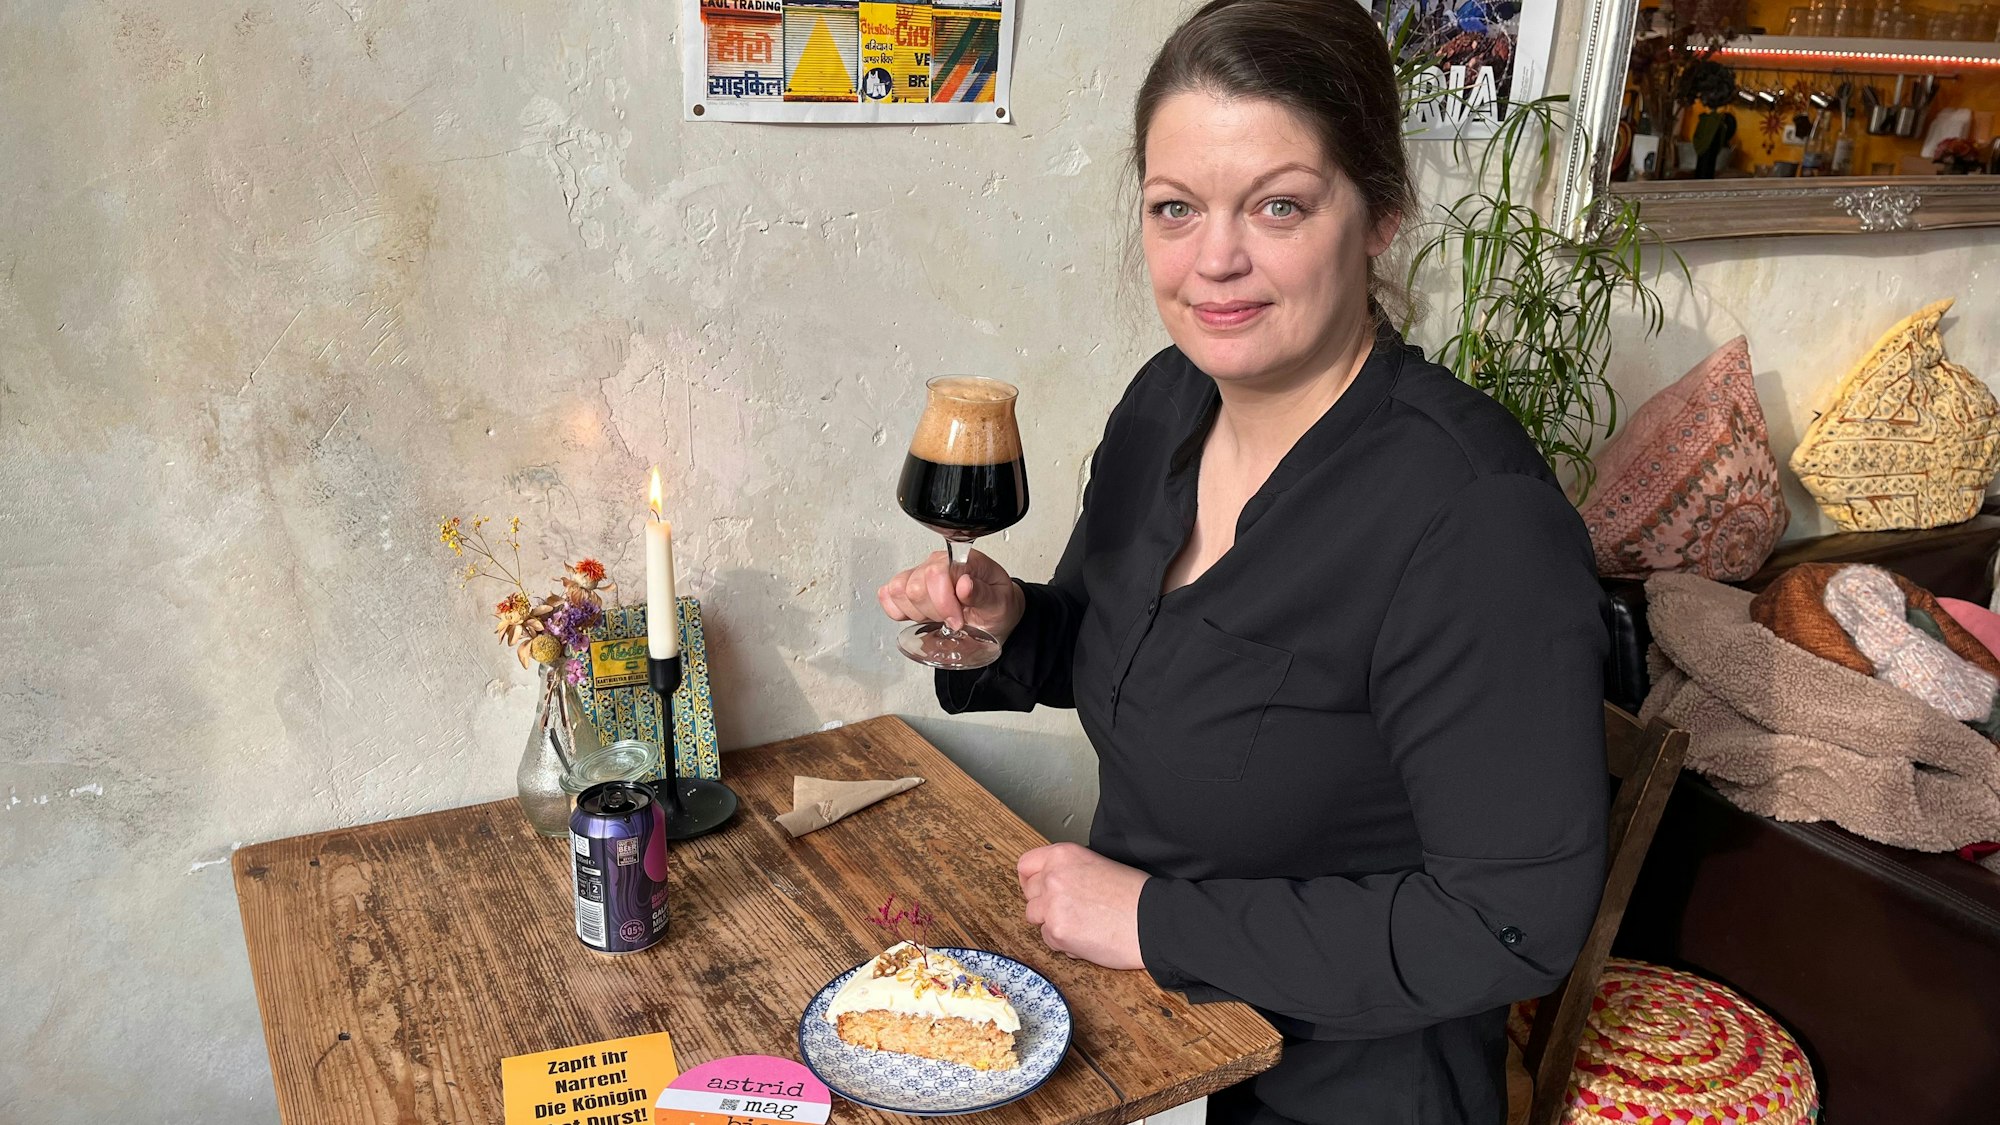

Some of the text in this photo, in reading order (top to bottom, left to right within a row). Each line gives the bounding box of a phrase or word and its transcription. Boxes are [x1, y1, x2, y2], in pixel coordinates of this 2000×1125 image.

[733, 0, 781, 12] TRADING
[717, 30, 774, 63] हीरो
[708, 70, 784, 99] साइकिल
[908, 74, 930, 88] BR
[1399, 64, 1500, 123] RIA
[592, 885, 599, 894] 2
[547, 1050, 628, 1075] Zapft ihr
[555, 1069, 628, 1094] Narren!
[706, 1077, 805, 1098] astrid
[534, 1087, 648, 1119] Die Königin
[742, 1100, 798, 1120] mag
[586, 1107, 648, 1125] Durst!
